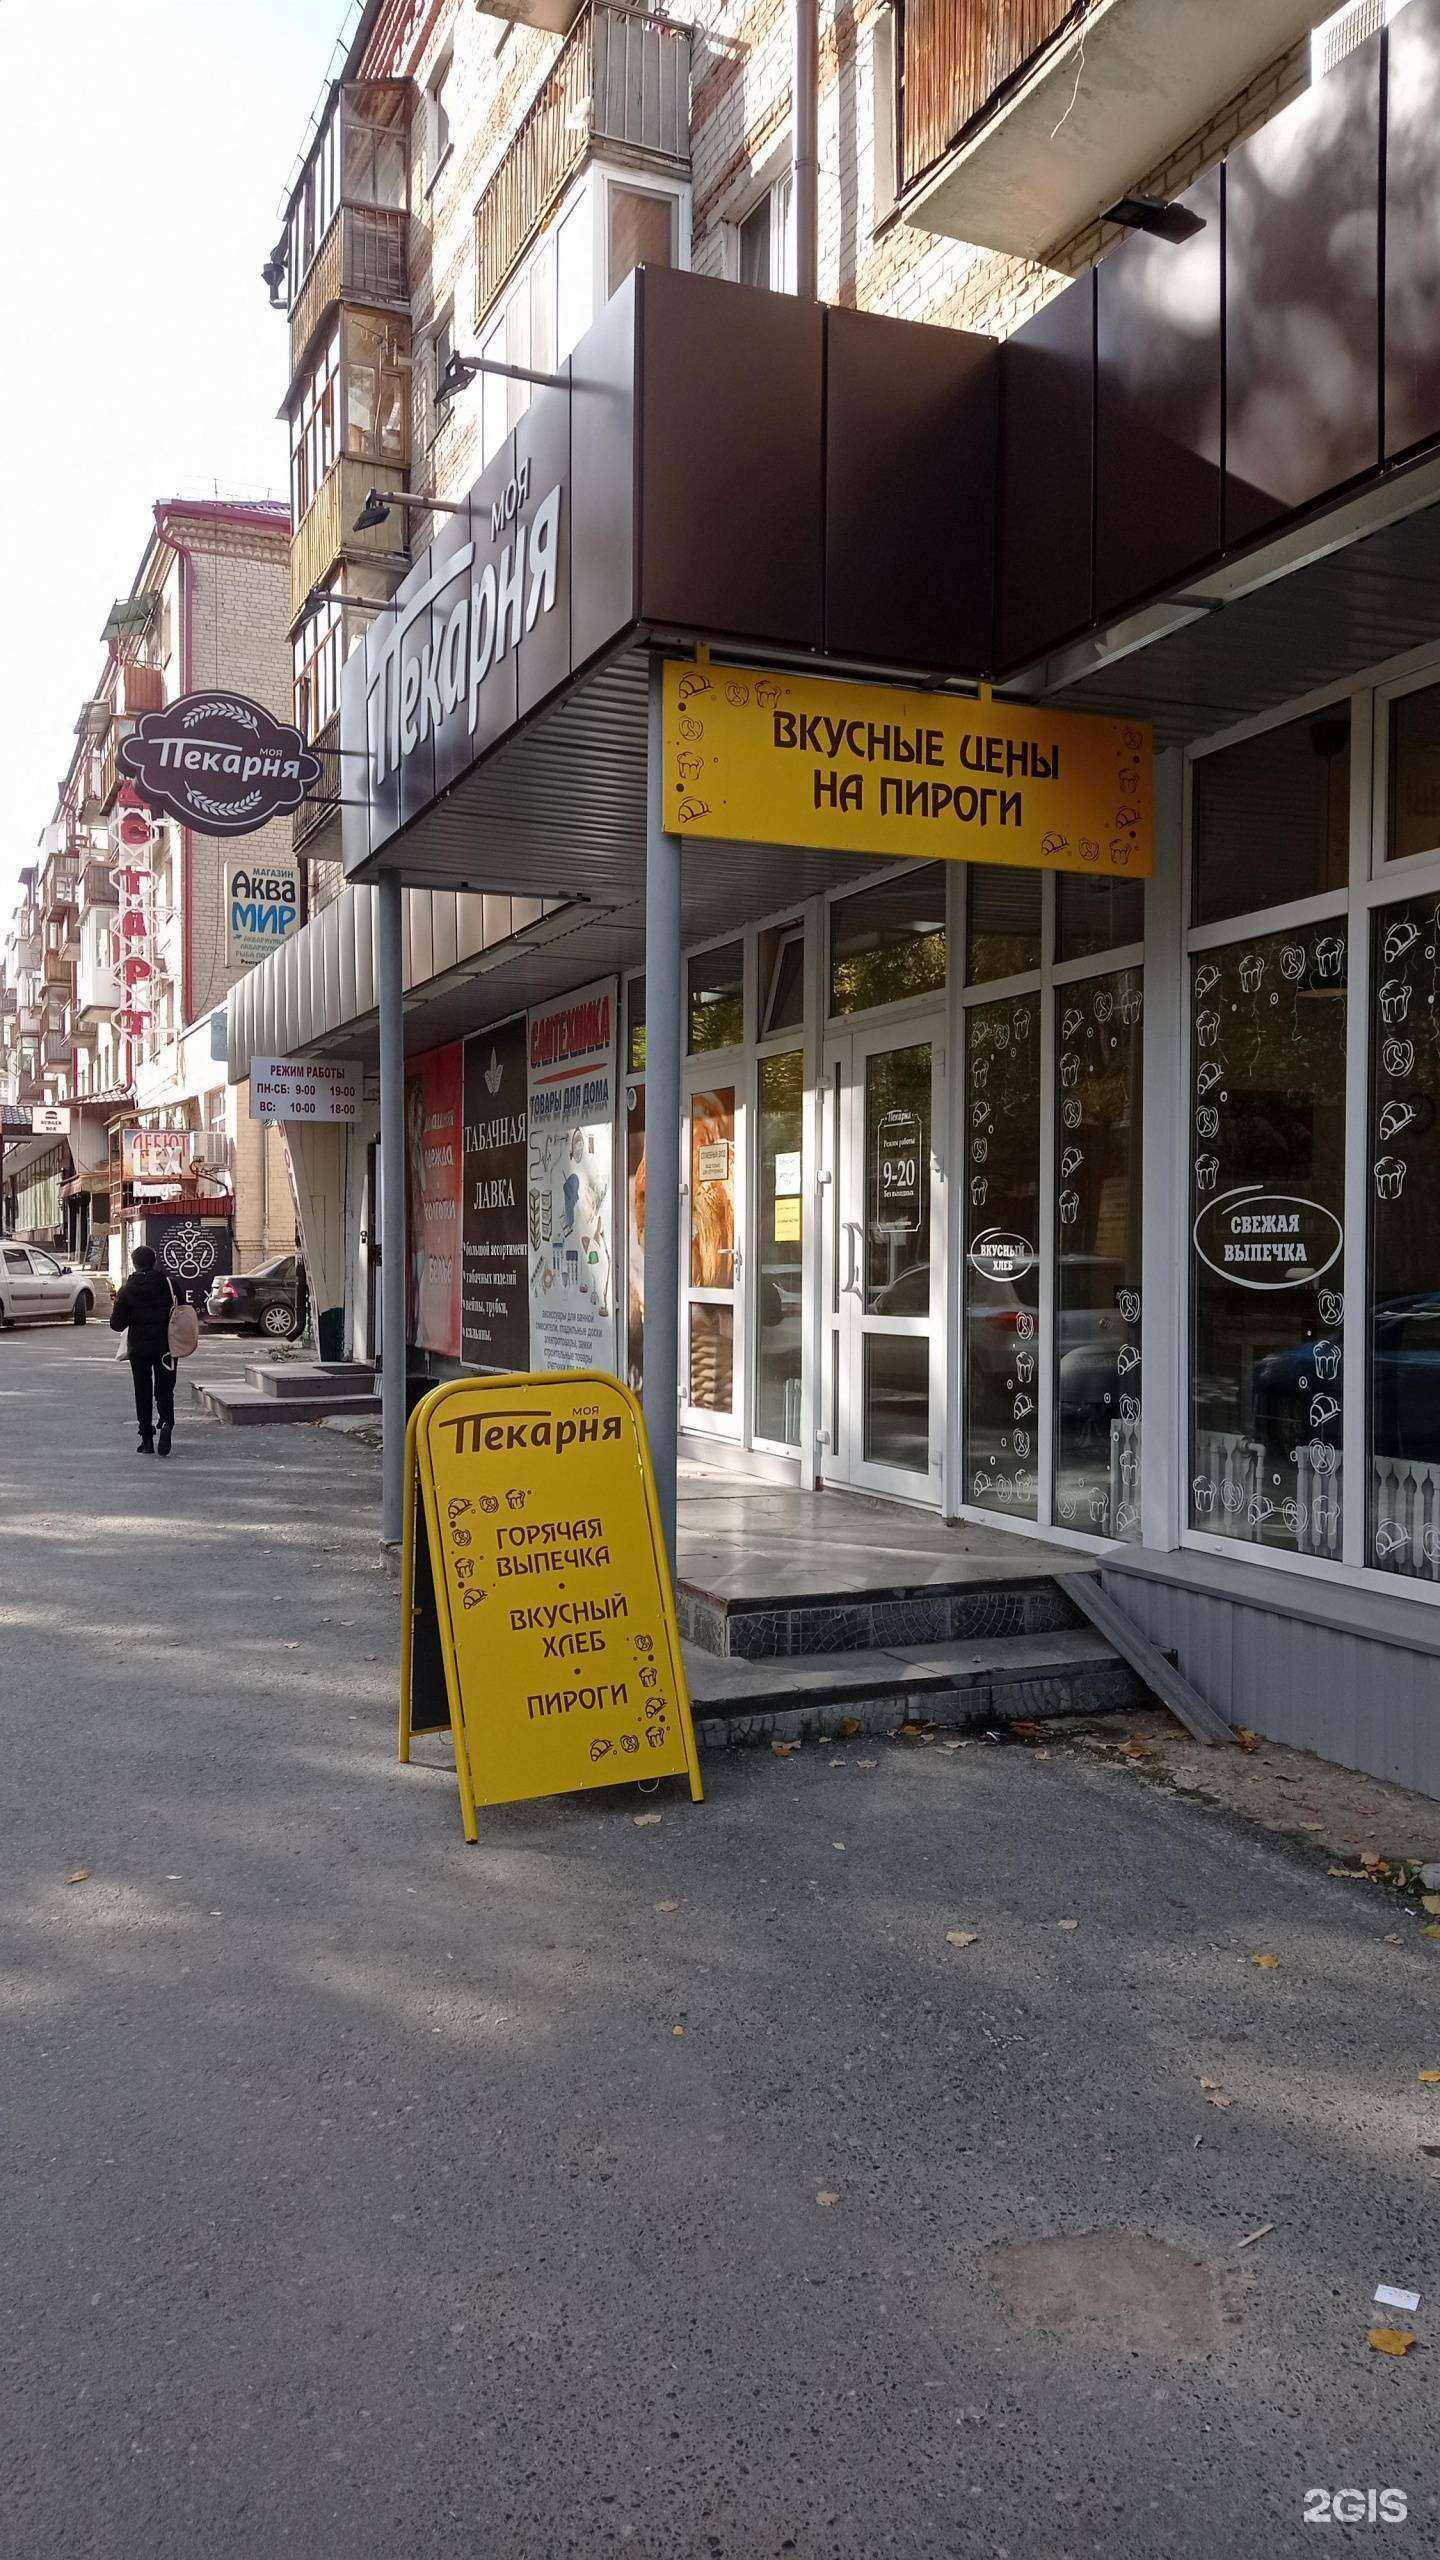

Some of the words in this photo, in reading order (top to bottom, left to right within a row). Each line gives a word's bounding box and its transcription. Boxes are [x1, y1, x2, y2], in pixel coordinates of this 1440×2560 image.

[365, 485, 561, 785] Пекарня
[148, 739, 300, 782] Пекарня
[773, 711, 944, 767] ВКУСНЫЕ
[960, 734, 1059, 779] ЦЕНЫ
[813, 769, 864, 812] НА
[880, 777, 1022, 826] ПИРОГИ
[253, 868, 293, 878] МАГАЗИН
[232, 902, 296, 934] МИР
[531, 996, 609, 1068] САНТЕХНИКА
[270, 1065, 304, 1077] РЕЖИМ
[307, 1067, 345, 1079] РАБОТЫ
[257, 1083, 290, 1094] ПН-СБ:
[295, 1085, 316, 1095] 9-00
[330, 1087, 355, 1096] 19-00
[530, 1090, 561, 1116] ТОВАРЫ
[563, 1083, 580, 1110] ДЛЯ
[582, 1078, 608, 1107] ДОМА
[260, 1102, 276, 1112] ВС:
[290, 1102, 316, 1113] 10-00
[330, 1104, 355, 1114] 18-00
[465, 1113, 526, 1153] ТАБАЧНАЯ
[883, 1160, 915, 1188] 9-20
[474, 1178, 515, 1211] ЛАВКА
[1231, 1214, 1299, 1233] СВЕЖАЯ
[980, 1242, 1025, 1257] ВКУСНЫЙ
[993, 1260, 1013, 1270] ХЛЕБ
[1224, 1243, 1307, 1261] ВЫПЕЧКА
[439, 1411, 622, 1454] Пекарня
[496, 1518, 602, 1550] ГОРЯЧАЯ
[497, 1545, 610, 1577] ВЫПЕЧКА
[509, 1593, 628, 1631] ВКУСНЫЙ
[542, 1630, 606, 1658] ХЛЕБ
[527, 1683, 628, 1719] ПИРОГИ
